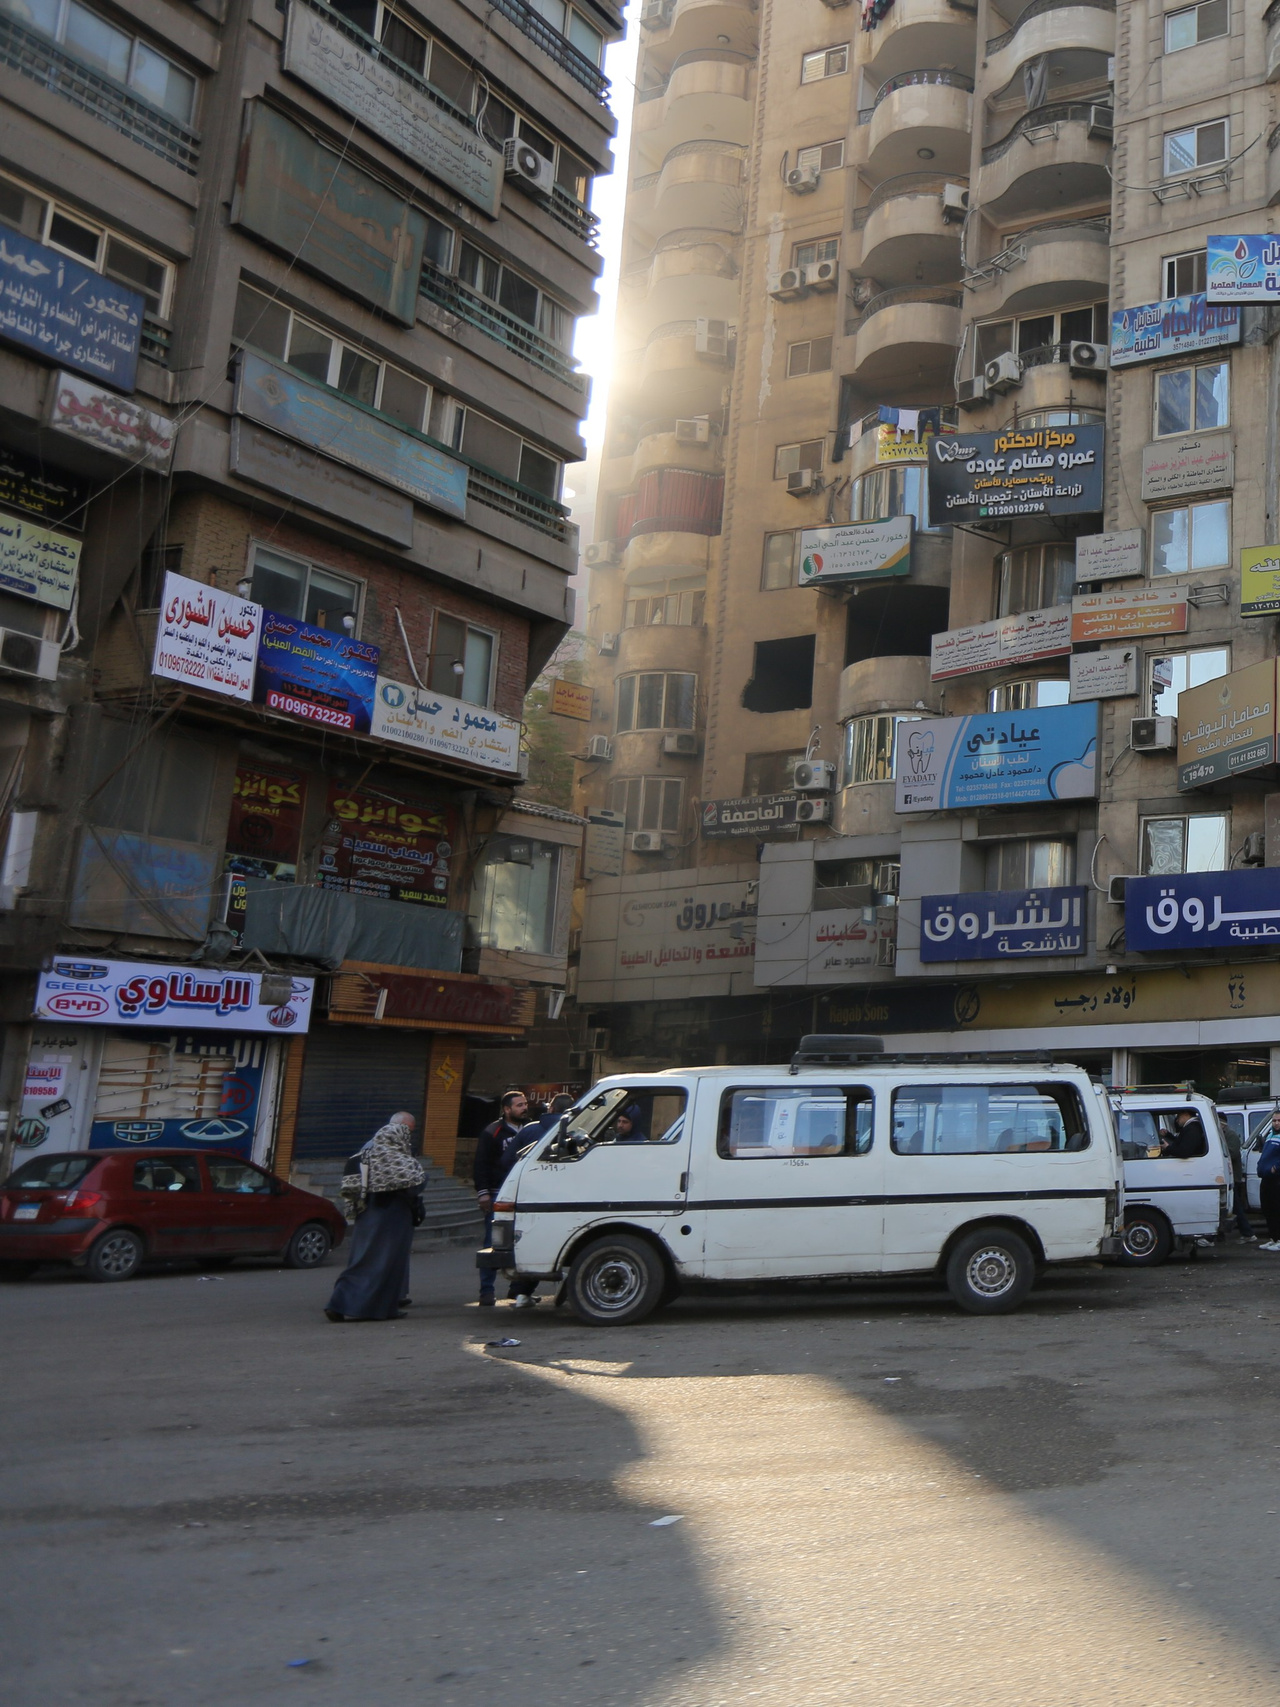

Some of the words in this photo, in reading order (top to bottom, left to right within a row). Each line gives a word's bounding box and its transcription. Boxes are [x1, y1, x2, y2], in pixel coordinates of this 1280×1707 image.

[1210, 281, 1235, 290] المتميز
[83, 295, 139, 326] دكتور
[1134, 308, 1161, 332] للتحاليل
[1134, 332, 1160, 355] الطبية
[994, 431, 1042, 453] الدكتور
[1045, 430, 1076, 449] مركز
[1177, 442, 1201, 453] دكتور
[1009, 449, 1054, 475] هشام
[1058, 450, 1095, 469] عمرو
[946, 491, 978, 508] الأسنان
[980, 490, 1012, 505] تجميل
[1020, 485, 1053, 501] الأسنان
[988, 503, 1045, 515] 01200102796
[32, 541, 76, 559] دكتور
[856, 537, 879, 546] محسن
[1106, 596, 1127, 605] جاد
[1132, 592, 1159, 602] خالد
[165, 590, 216, 629] الشورى
[239, 606, 256, 617] دكتور
[1082, 613, 1117, 624] القلب
[1120, 607, 1175, 621] استشارى
[218, 608, 255, 644] حسين
[265, 614, 297, 635] حسن
[1117, 623, 1145, 631] القلب
[300, 628, 332, 648] محمد
[978, 630, 998, 641] وسام
[159, 651, 205, 679] 01096732222
[270, 694, 351, 728] 01096732222
[407, 691, 442, 716] حسن
[452, 707, 497, 733] محمود
[1229, 702, 1270, 730] معامل
[441, 727, 462, 740] الفم
[967, 723, 1041, 753] عيادتى
[1181, 714, 1227, 746] البوشي
[1222, 726, 1253, 748] للتحاليل
[1197, 739, 1221, 755] الطبية
[1006, 752, 1029, 765] لطب
[902, 773, 938, 783] EYADATY
[959, 772, 985, 781] محمود
[985, 768, 1004, 779] عادل
[1189, 762, 1215, 781] 19470
[721, 805, 783, 823] العاصمة
[366, 830, 417, 846] العميد
[399, 889, 421, 900] سعيد
[923, 893, 1081, 943] الشروق
[816, 923, 867, 946] كلينك
[997, 933, 1081, 954] للأشعة
[621, 950, 652, 969] الطبية
[45, 981, 113, 993] GEELY
[117, 972, 251, 1016] الإسناوي
[1103, 975, 1136, 1009] أولاد
[1228, 980, 1247, 1001] ٢٤
[55, 999, 100, 1011] BYD
[863, 1004, 889, 1021] Sons
[1054, 994, 1098, 1015] رجب
[269, 1008, 295, 1024] MG
